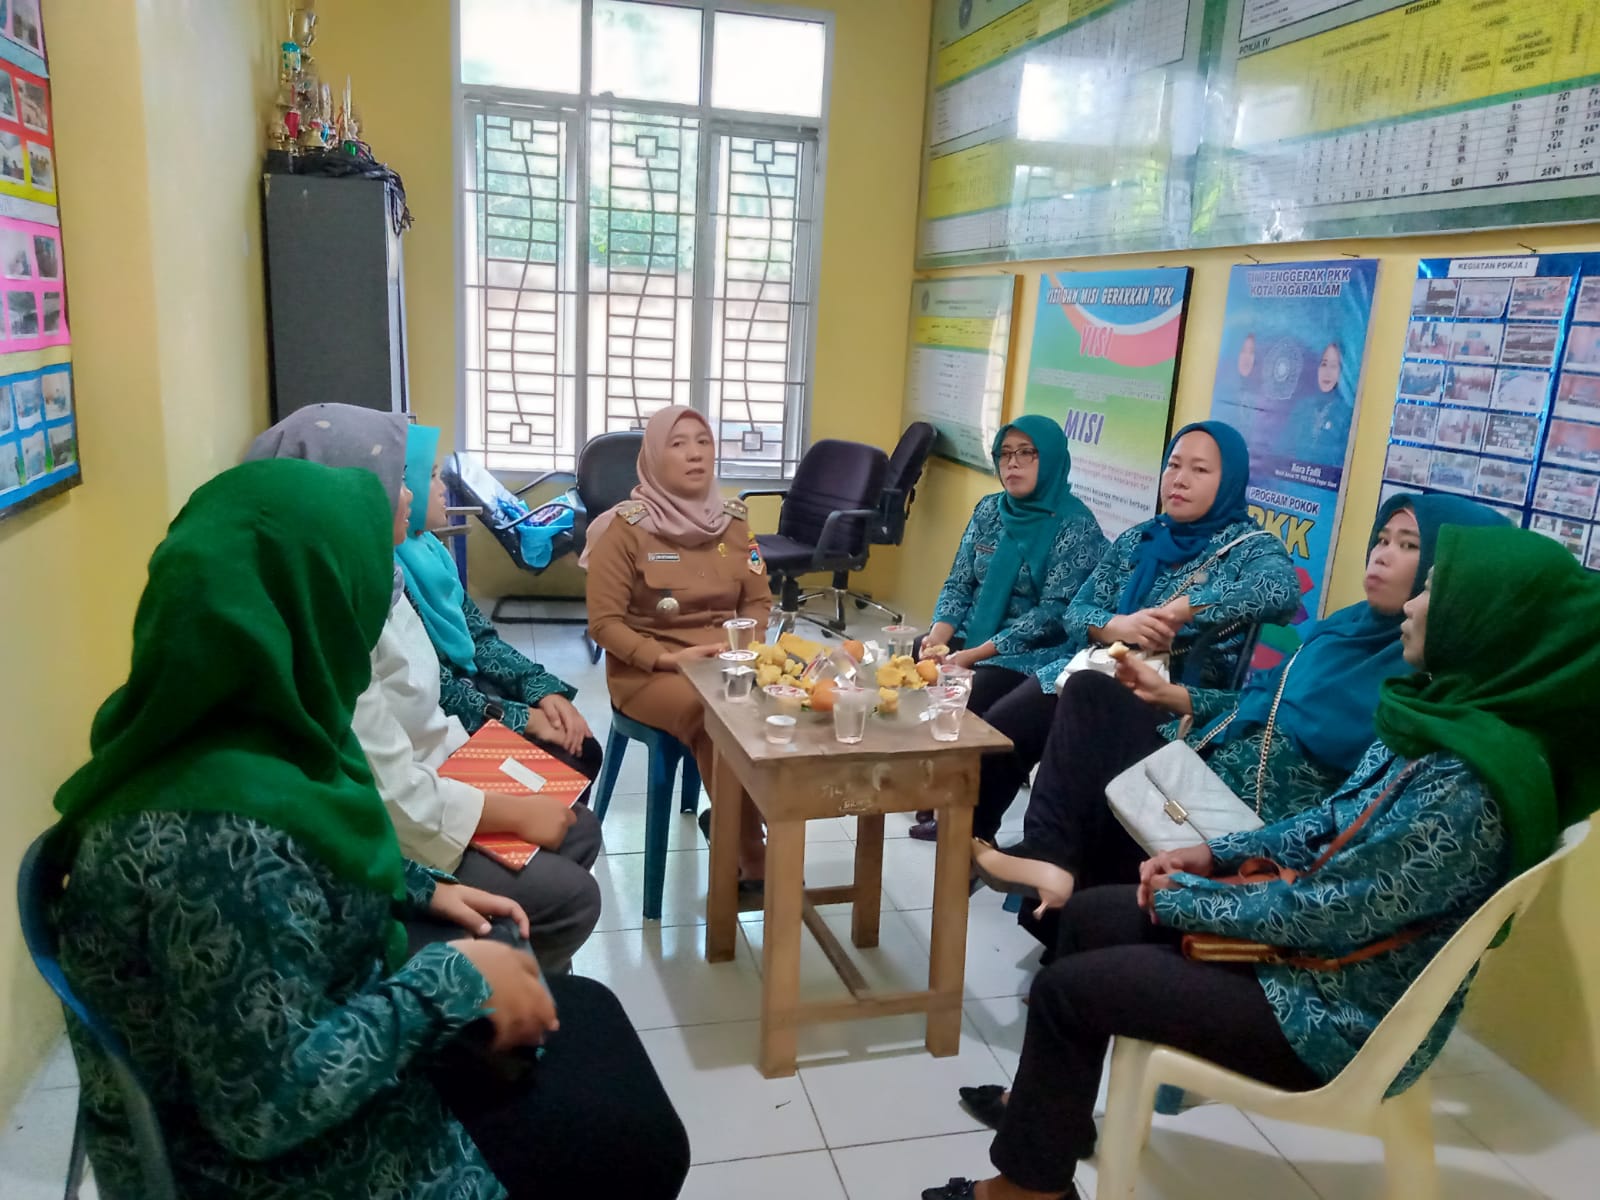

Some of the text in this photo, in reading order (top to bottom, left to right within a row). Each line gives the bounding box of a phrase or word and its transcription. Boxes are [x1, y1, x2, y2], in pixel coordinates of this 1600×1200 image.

[1264, 268, 1326, 283] PENGGERAK
[1327, 268, 1351, 281] PKK
[1458, 262, 1495, 270] KEGIATAN
[1062, 288, 1078, 305] DAN
[1080, 287, 1099, 305] MISI
[1101, 286, 1151, 306] GERAKKAN
[1152, 285, 1175, 306] PKK
[1251, 283, 1341, 296] KOTA PAGAR ALAM
[1079, 325, 1114, 358] VISI
[1063, 408, 1105, 446] MISI
[1250, 488, 1320, 515] PROGRAM POKOK
